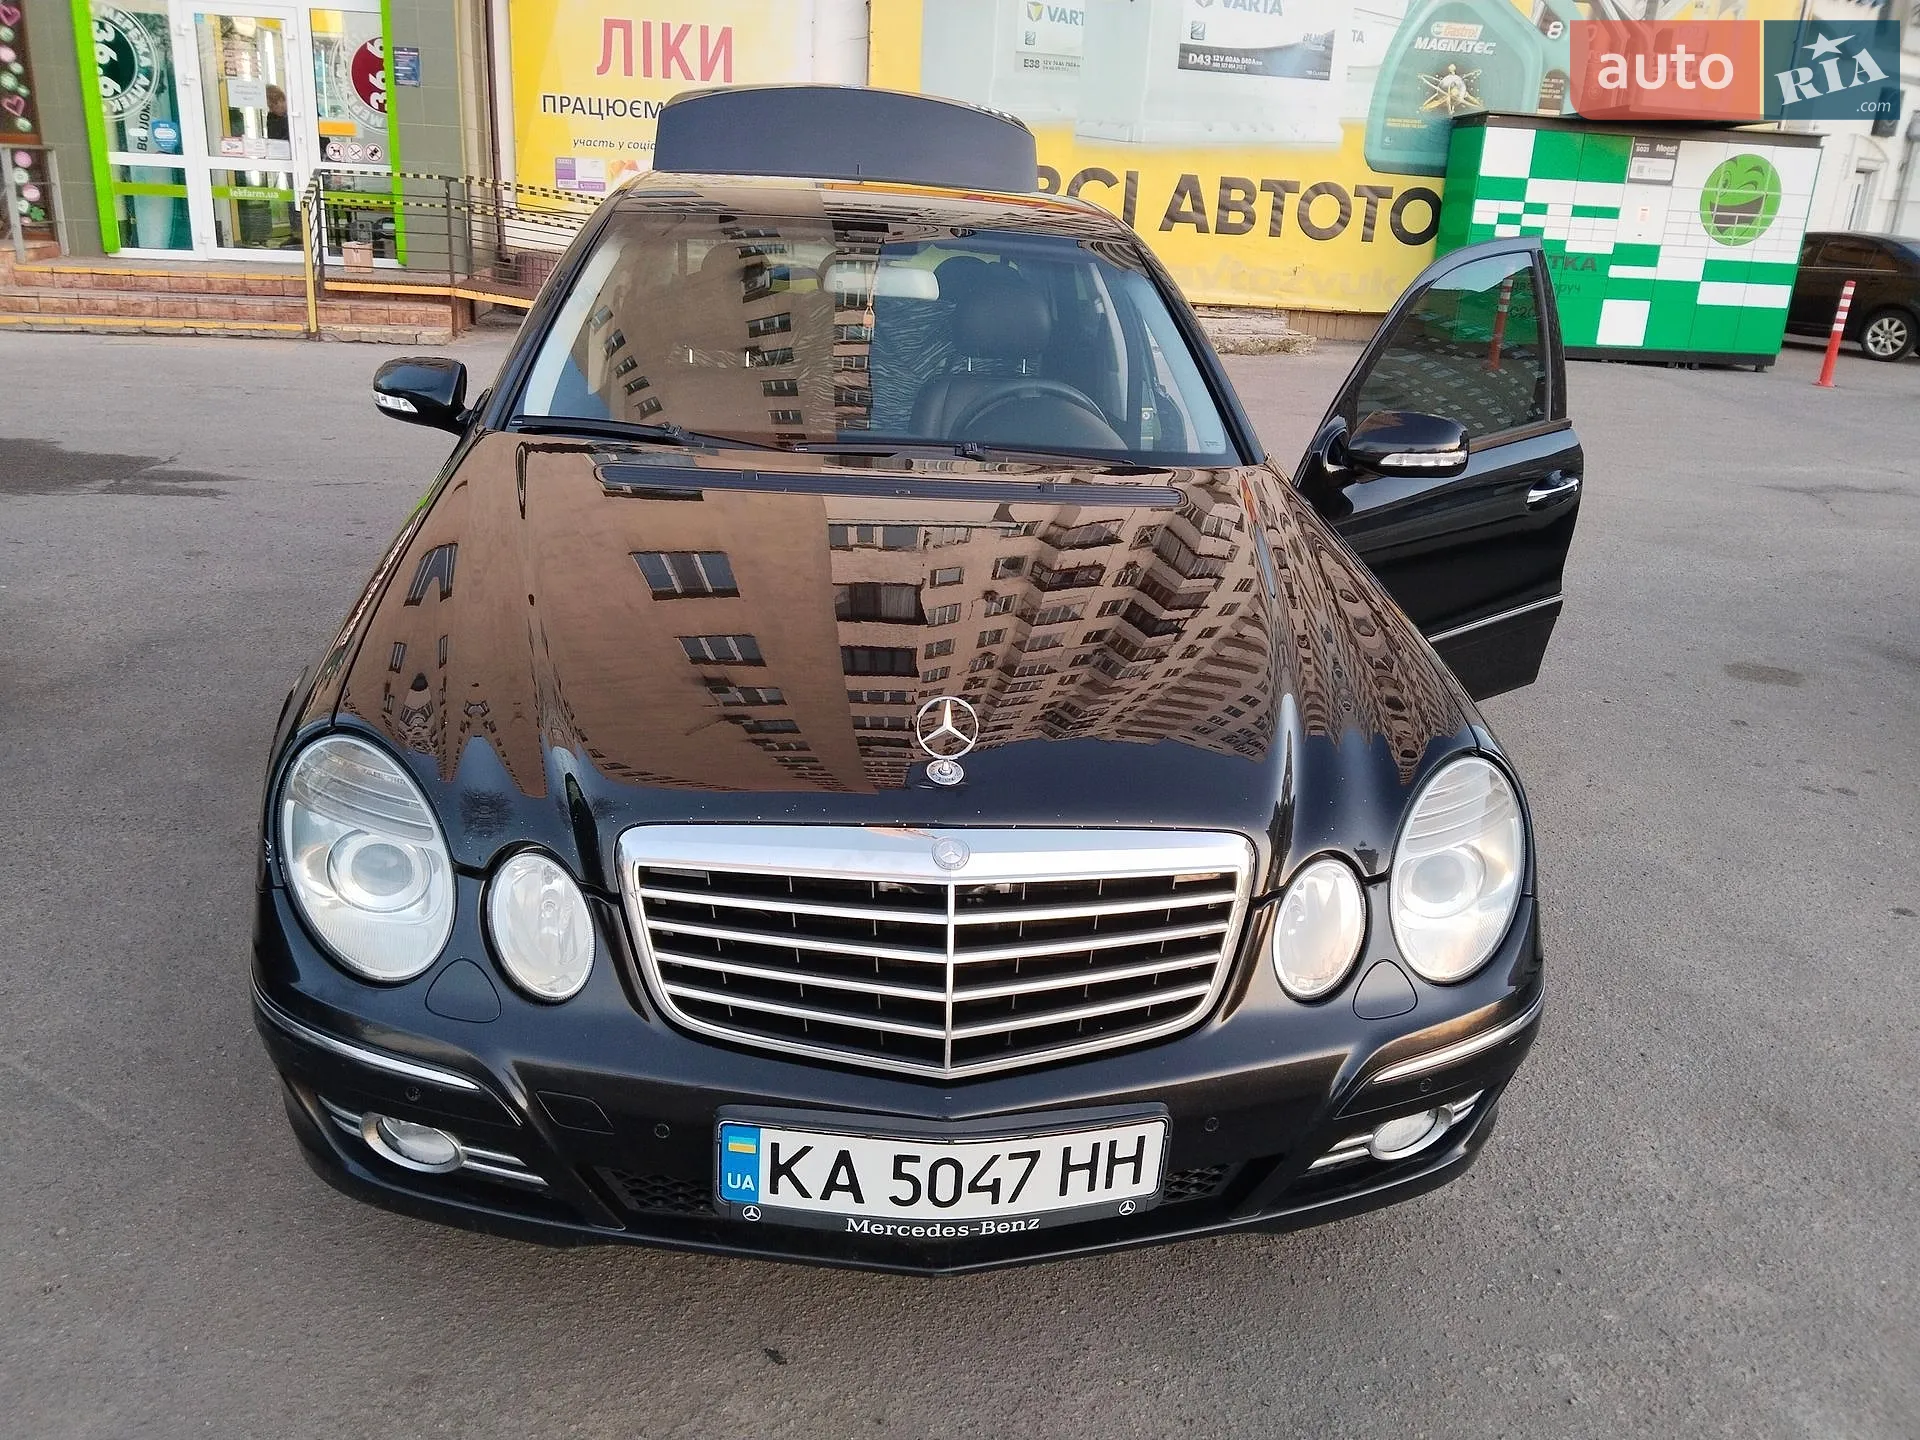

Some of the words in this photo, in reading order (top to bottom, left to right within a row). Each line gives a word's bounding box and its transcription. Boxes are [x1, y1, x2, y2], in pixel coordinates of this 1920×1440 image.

[597, 18, 733, 83] ЛІКИ
[1415, 36, 1497, 55] MAGNATEC
[1188, 52, 1212, 66] D43
[366, 38, 387, 113] 366
[542, 94, 664, 120] ПРАЦЮЄМ
[573, 138, 615, 148] участь
[618, 141, 625, 150] у
[1159, 174, 1442, 246] АВТОТО
[727, 1172, 755, 1191] UA
[769, 1142, 865, 1204] KA
[888, 1150, 1041, 1208] 5047
[1059, 1134, 1146, 1197] HH
[845, 1217, 1040, 1237] Mercedes-Benz
